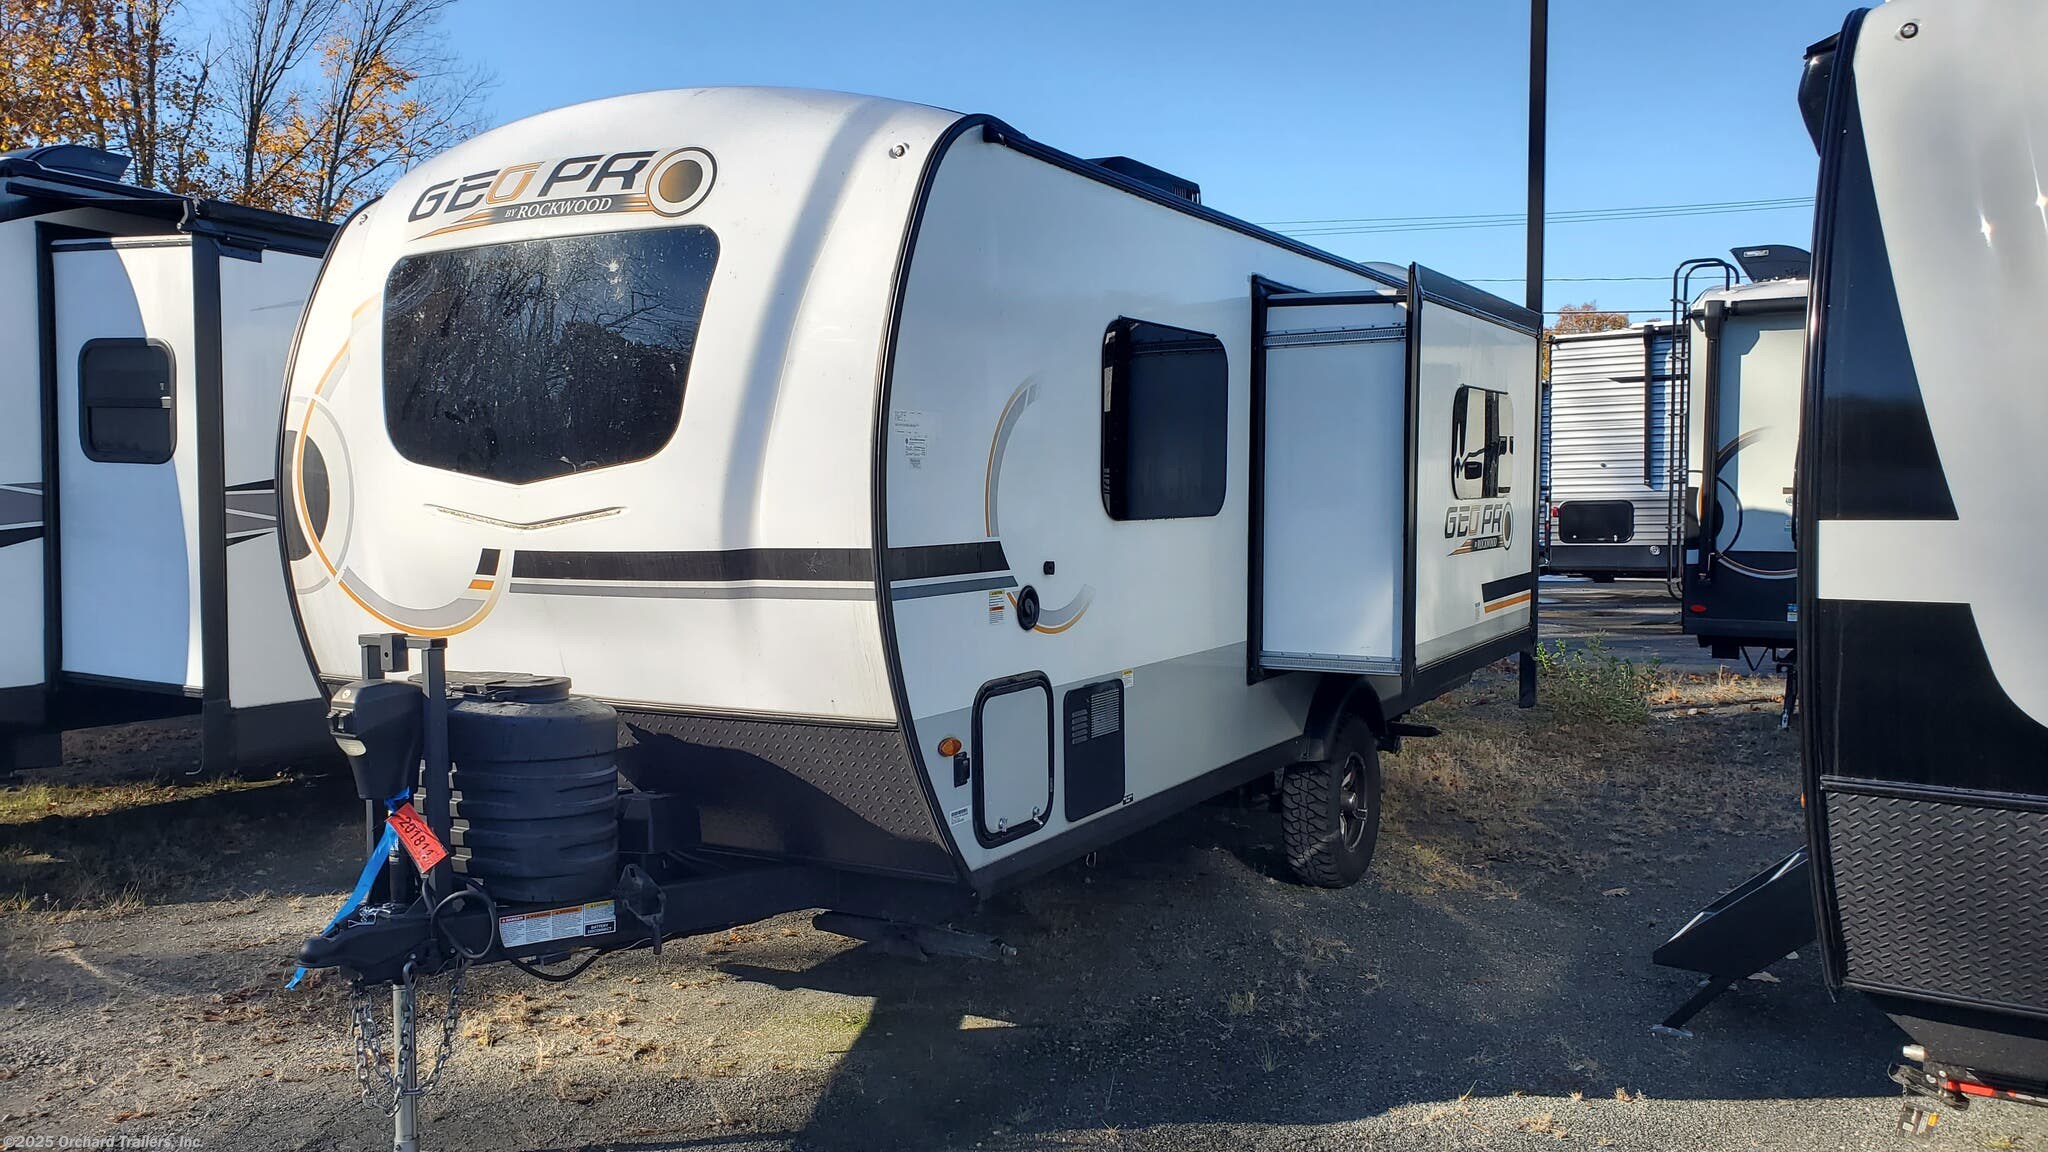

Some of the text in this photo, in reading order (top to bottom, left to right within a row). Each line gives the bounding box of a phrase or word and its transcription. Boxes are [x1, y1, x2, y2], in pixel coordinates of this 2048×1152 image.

[408, 146, 717, 222] GEO PRO
[504, 197, 612, 219] BY ROCKWOOD
[1444, 505, 1481, 538] GEO
